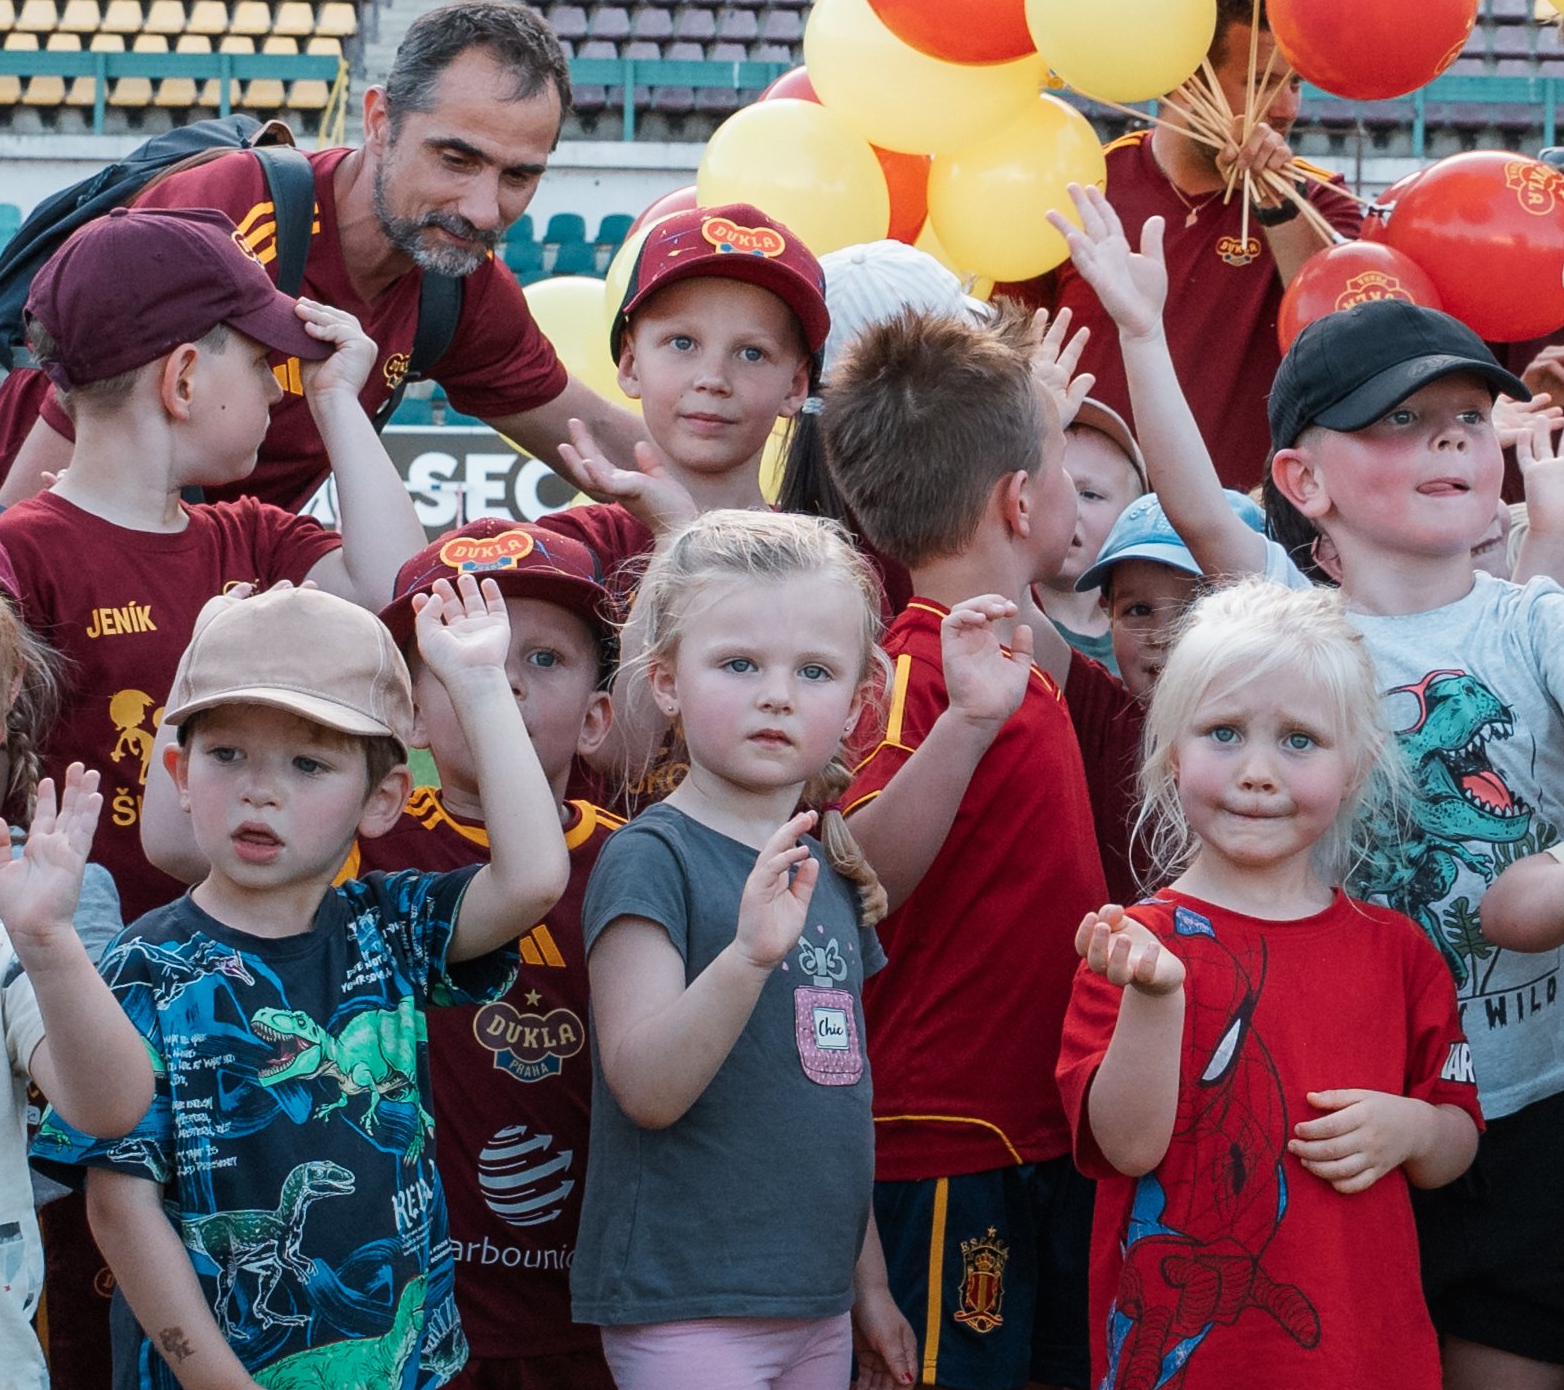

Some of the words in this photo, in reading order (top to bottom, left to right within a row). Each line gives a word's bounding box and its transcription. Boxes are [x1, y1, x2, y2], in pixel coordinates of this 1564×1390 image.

[713, 224, 777, 249] DUKLA
[454, 536, 524, 561] DUKLA
[85, 599, 158, 640] JENÍK
[1485, 974, 1558, 1032] WILD
[486, 1014, 577, 1050] DUKLA
[818, 1016, 844, 1037] Chic
[508, 1059, 549, 1077] PRAHA
